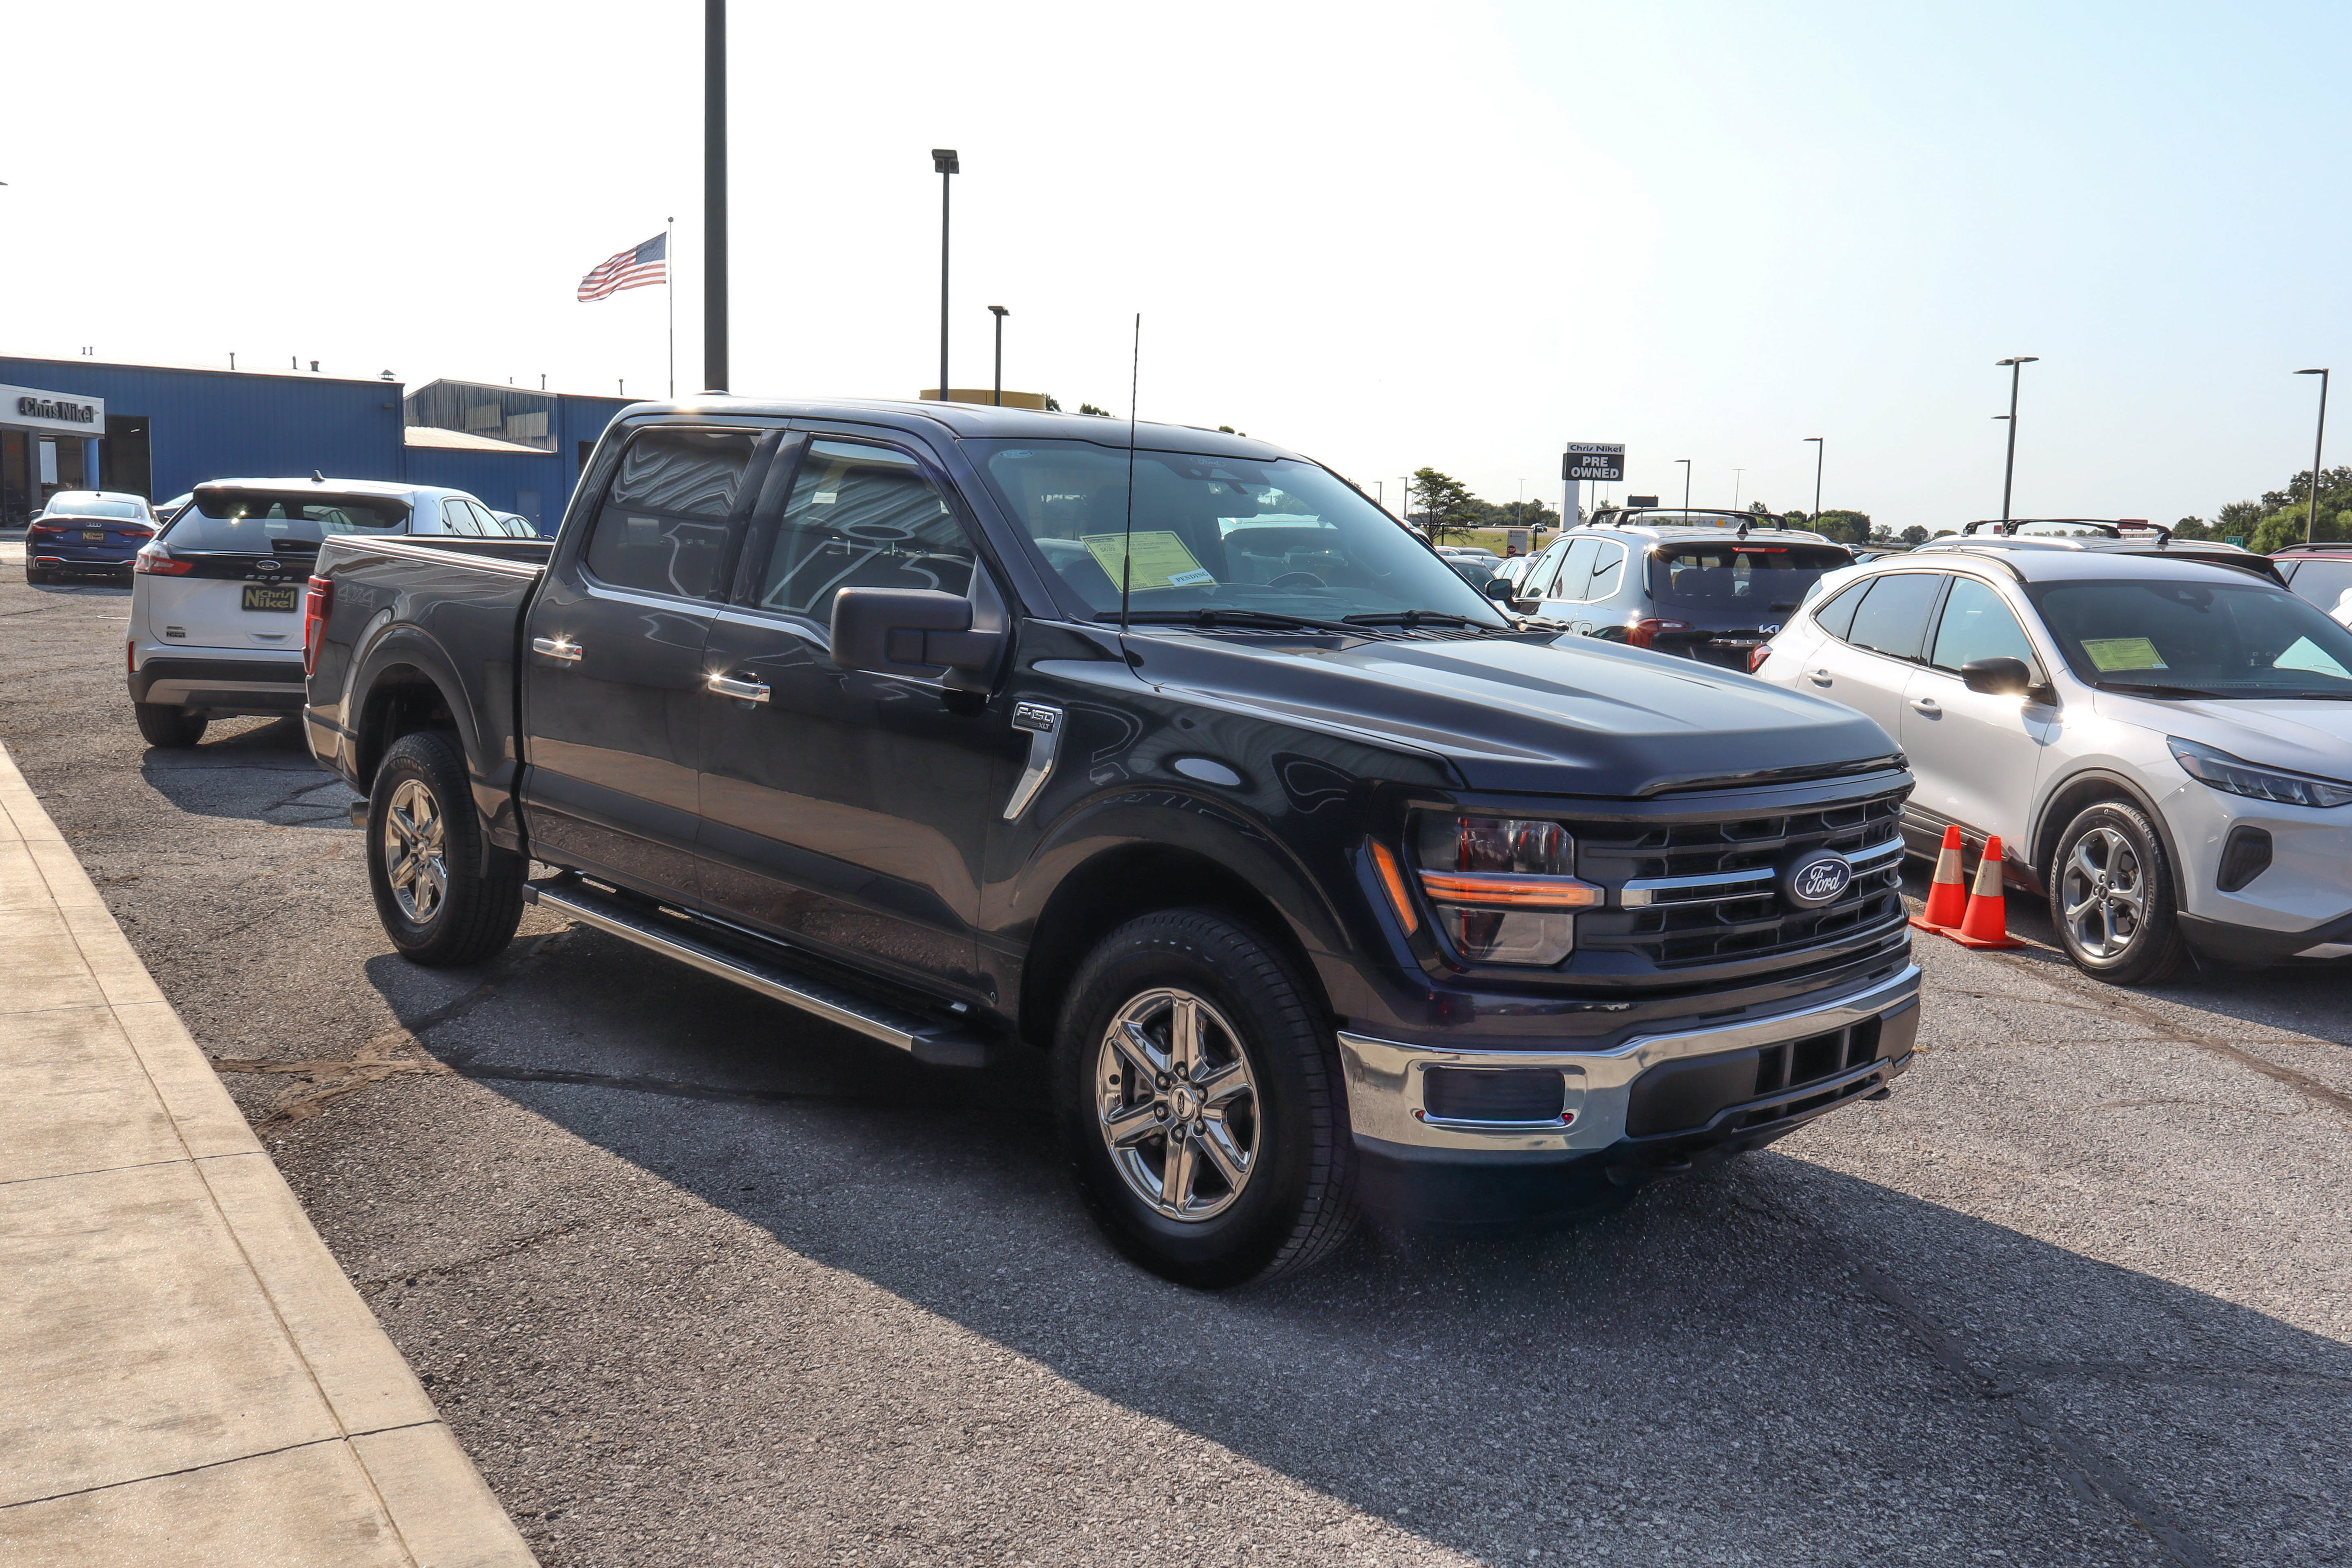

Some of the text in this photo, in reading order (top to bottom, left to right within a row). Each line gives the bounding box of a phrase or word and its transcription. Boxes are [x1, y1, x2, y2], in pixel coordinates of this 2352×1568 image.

[22, 397, 94, 423] Chris Nikel
[1582, 456, 1608, 467] PRE
[1571, 467, 1619, 479] OWNED
[1175, 571, 1209, 583] PENDING
[245, 589, 295, 608] Nikel
[260, 590, 290, 598] Chris
[1016, 706, 1054, 723] F-150
[1805, 865, 1841, 895] Ford
